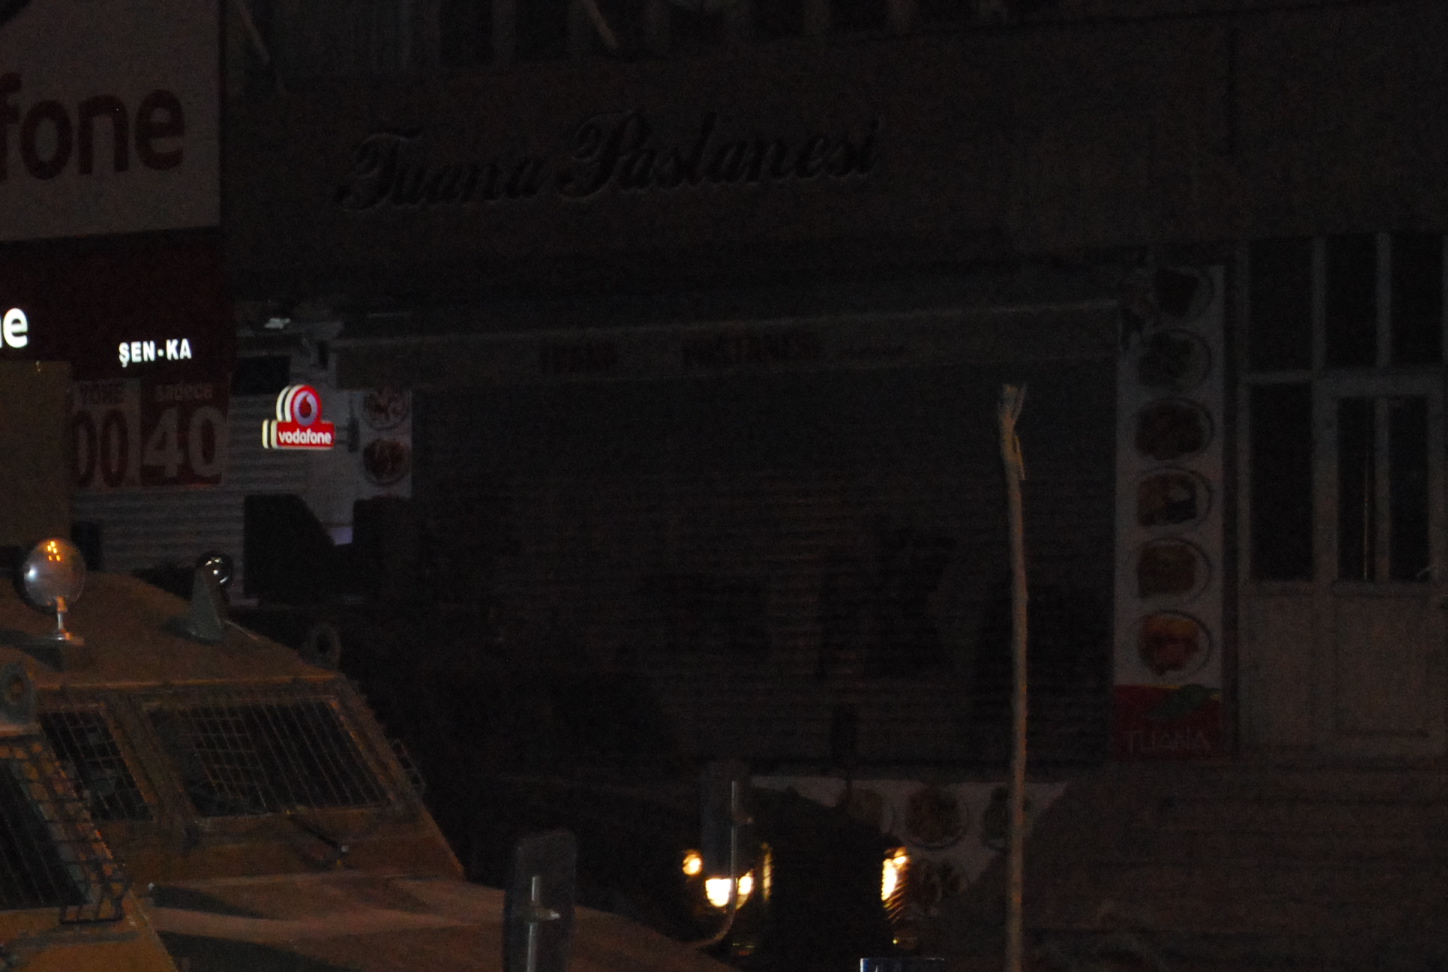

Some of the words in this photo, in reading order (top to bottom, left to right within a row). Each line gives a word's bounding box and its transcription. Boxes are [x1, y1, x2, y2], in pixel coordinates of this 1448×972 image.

[334, 126, 548, 209] Tuana
[142, 406, 230, 480] 40
[278, 428, 333, 445] vodafone
